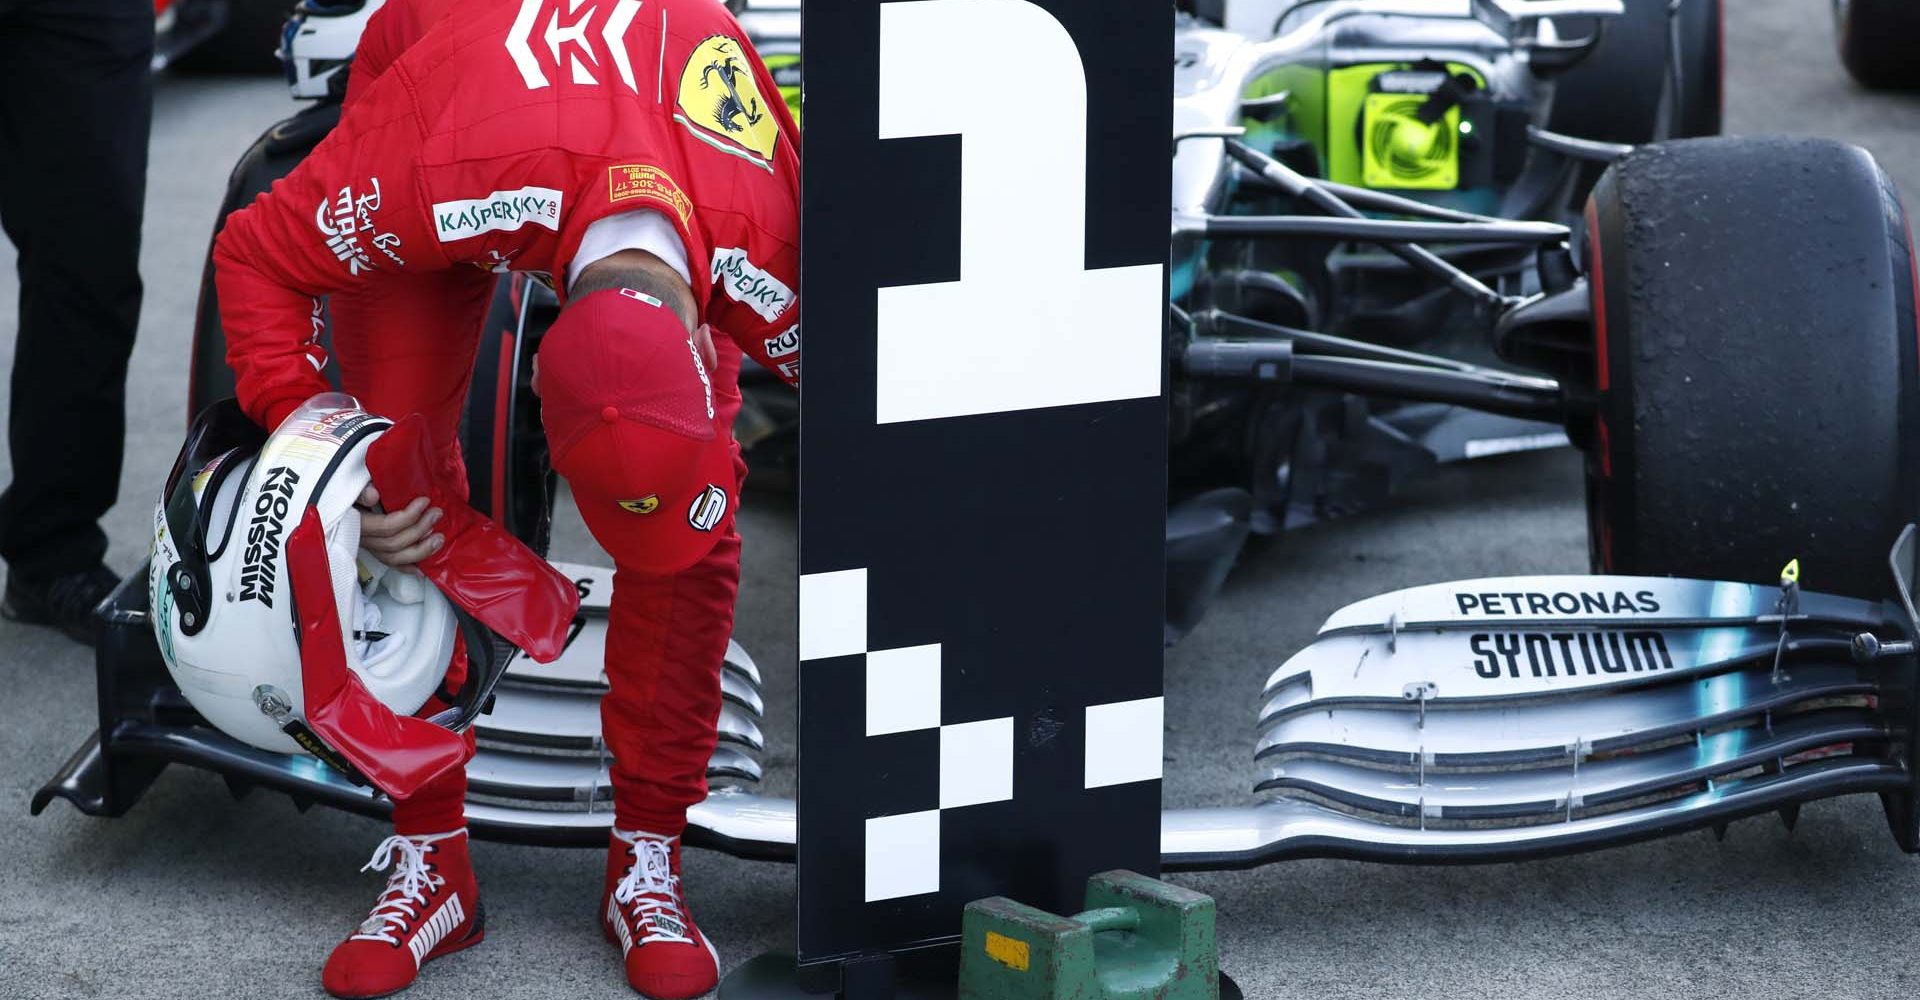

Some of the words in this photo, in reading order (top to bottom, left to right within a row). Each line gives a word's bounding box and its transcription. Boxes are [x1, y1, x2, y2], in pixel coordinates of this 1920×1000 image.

[356, 177, 405, 265] Ray-Ban
[439, 196, 546, 232] KASPERSKY
[546, 200, 557, 219] lab
[877, 0, 1163, 424] 1
[240, 466, 286, 601] MISSION
[1456, 591, 1661, 614] PETRONAS
[1470, 631, 1674, 678] SYNTIUM
[408, 892, 466, 971] PUMA
